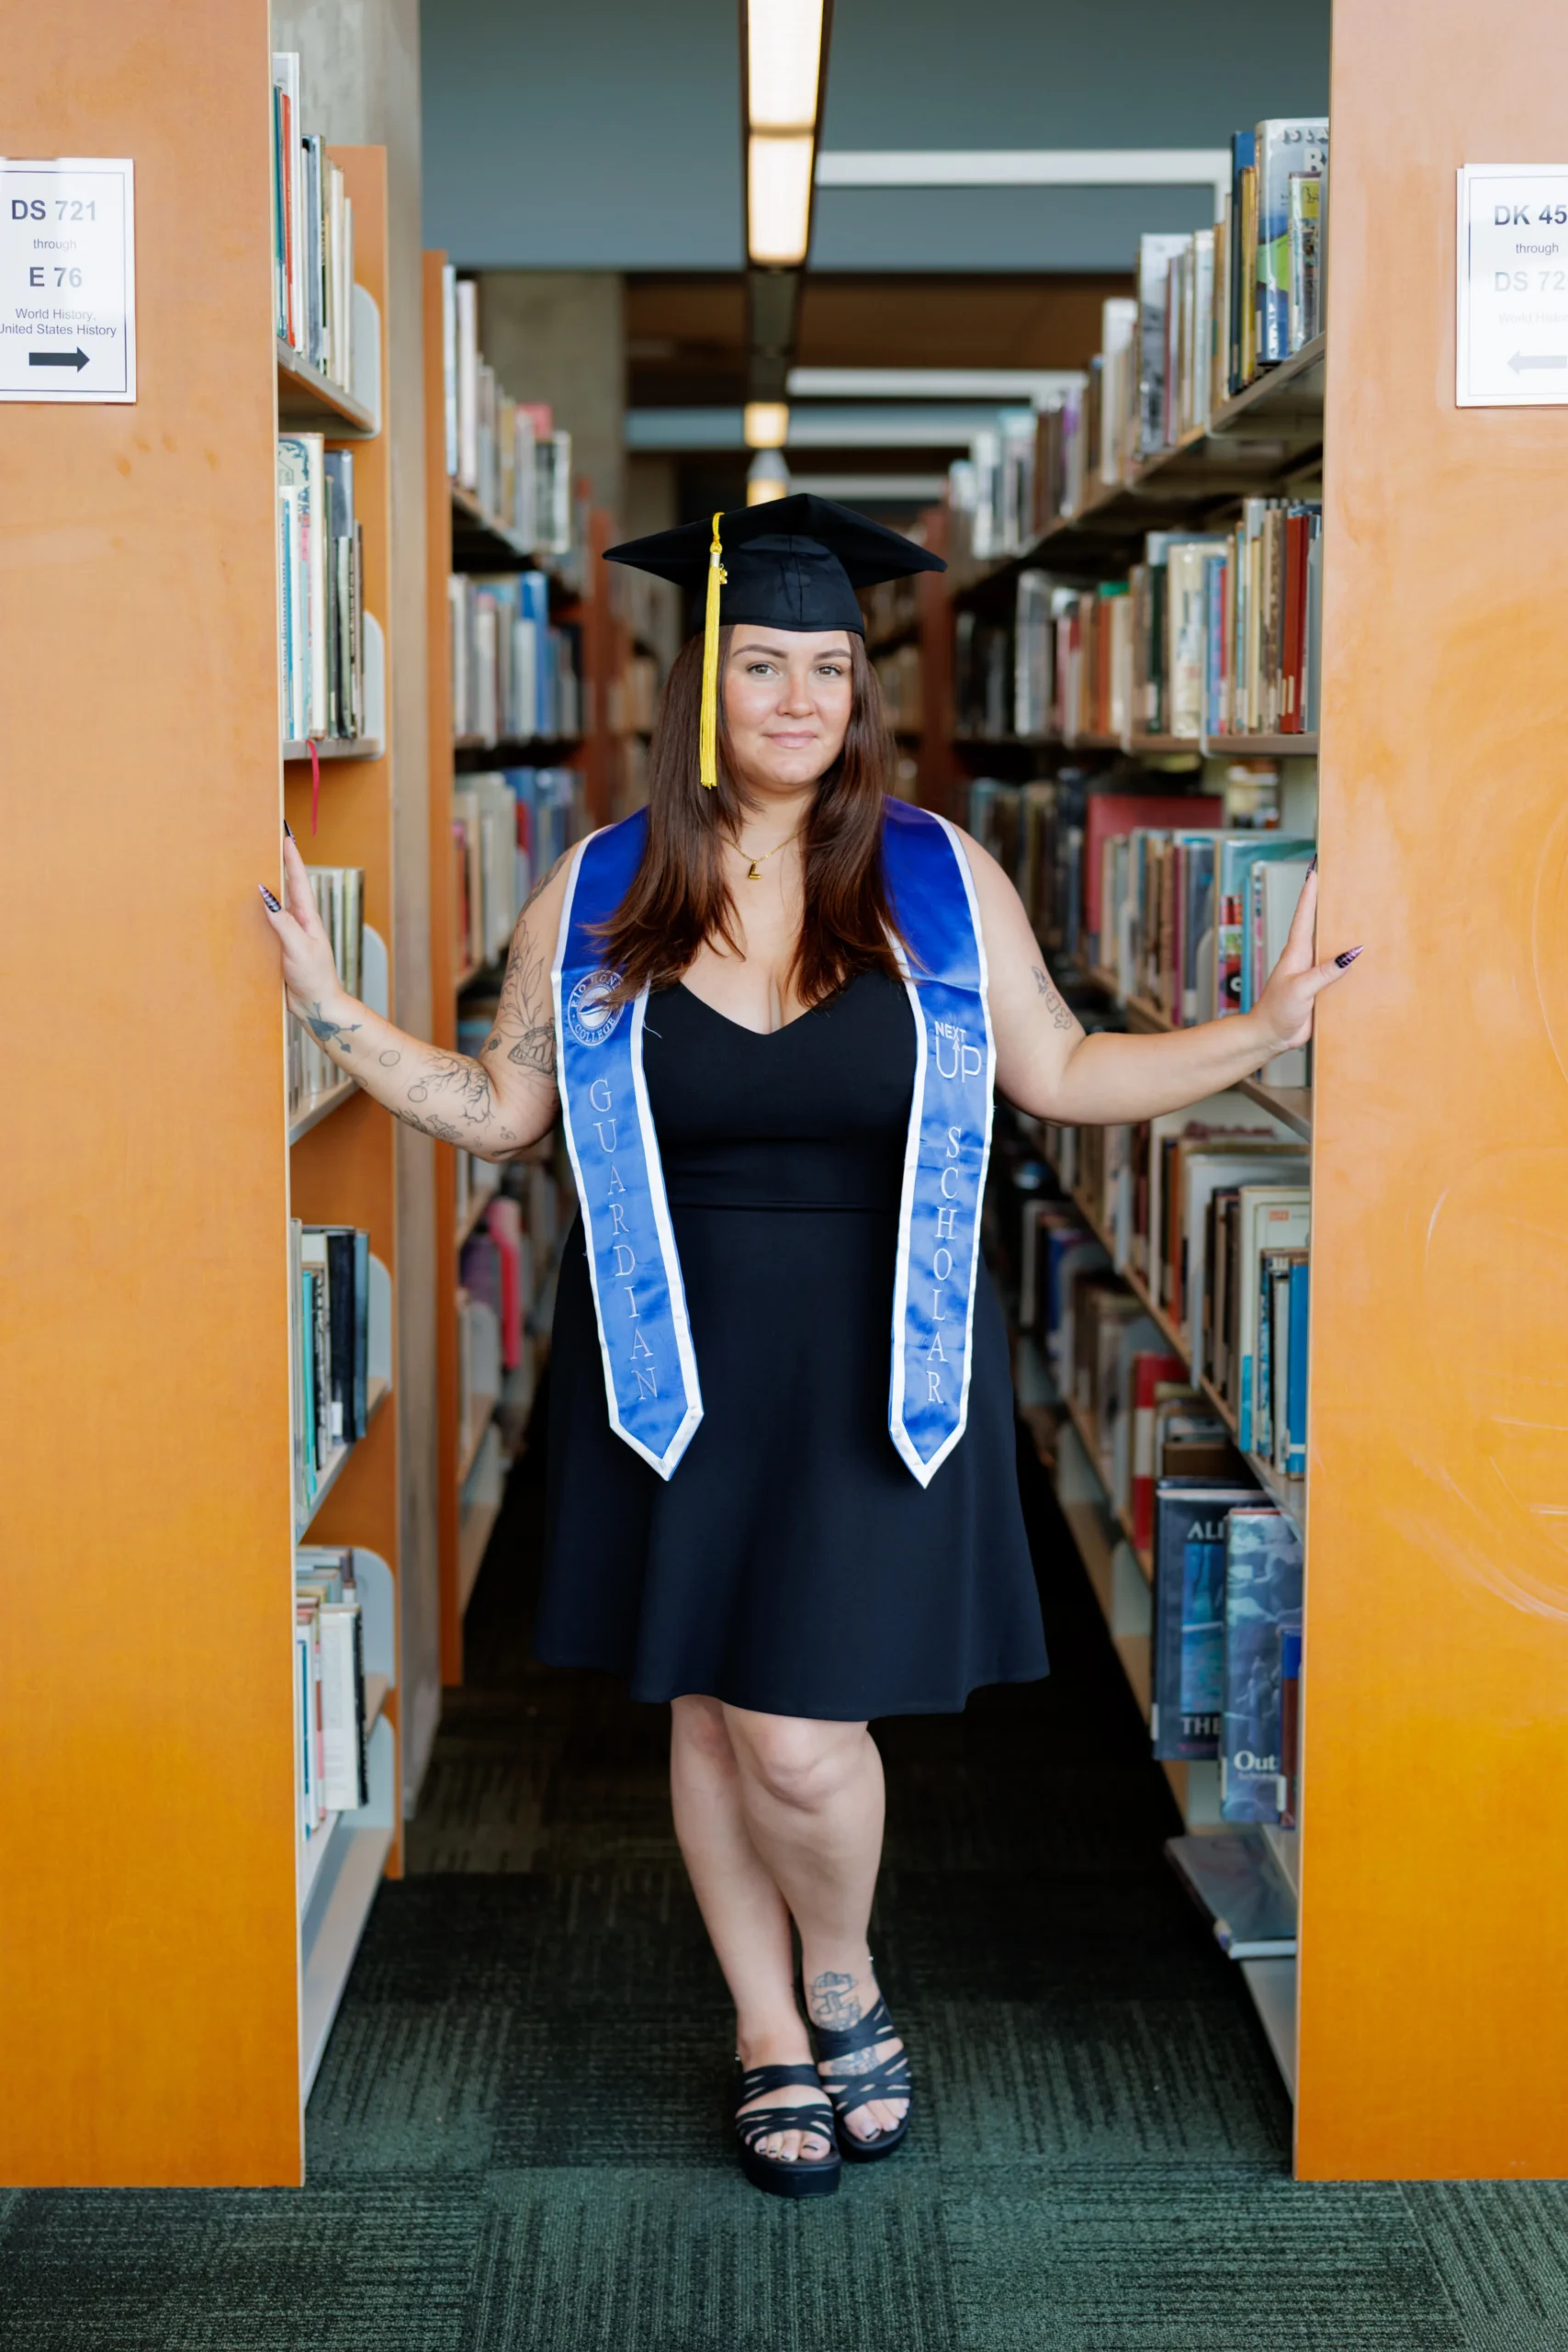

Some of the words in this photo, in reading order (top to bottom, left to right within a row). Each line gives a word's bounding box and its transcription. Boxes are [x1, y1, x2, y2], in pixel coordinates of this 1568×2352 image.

[11, 199, 47, 220] DS
[55, 200, 96, 221] 721
[1495, 205, 1530, 226] DK
[33, 238, 77, 252] through
[1516, 243, 1559, 255] through
[29, 266, 45, 288] E
[54, 267, 83, 288] 76
[1495, 270, 1529, 292] DS
[15, 308, 50, 320] World
[0, 322, 33, 334] United
[37, 323, 73, 335] States
[76, 324, 117, 338] History
[570, 984, 587, 1008] RIO
[575, 1017, 615, 1043] COLLEGE
[934, 1020, 967, 1044] NEXT
[935, 1035, 982, 1083] UP
[588, 1078, 659, 1401] GUARDIAN
[926, 1125, 964, 1405] SCHOLAR
[1234, 1749, 1278, 1771] Out
